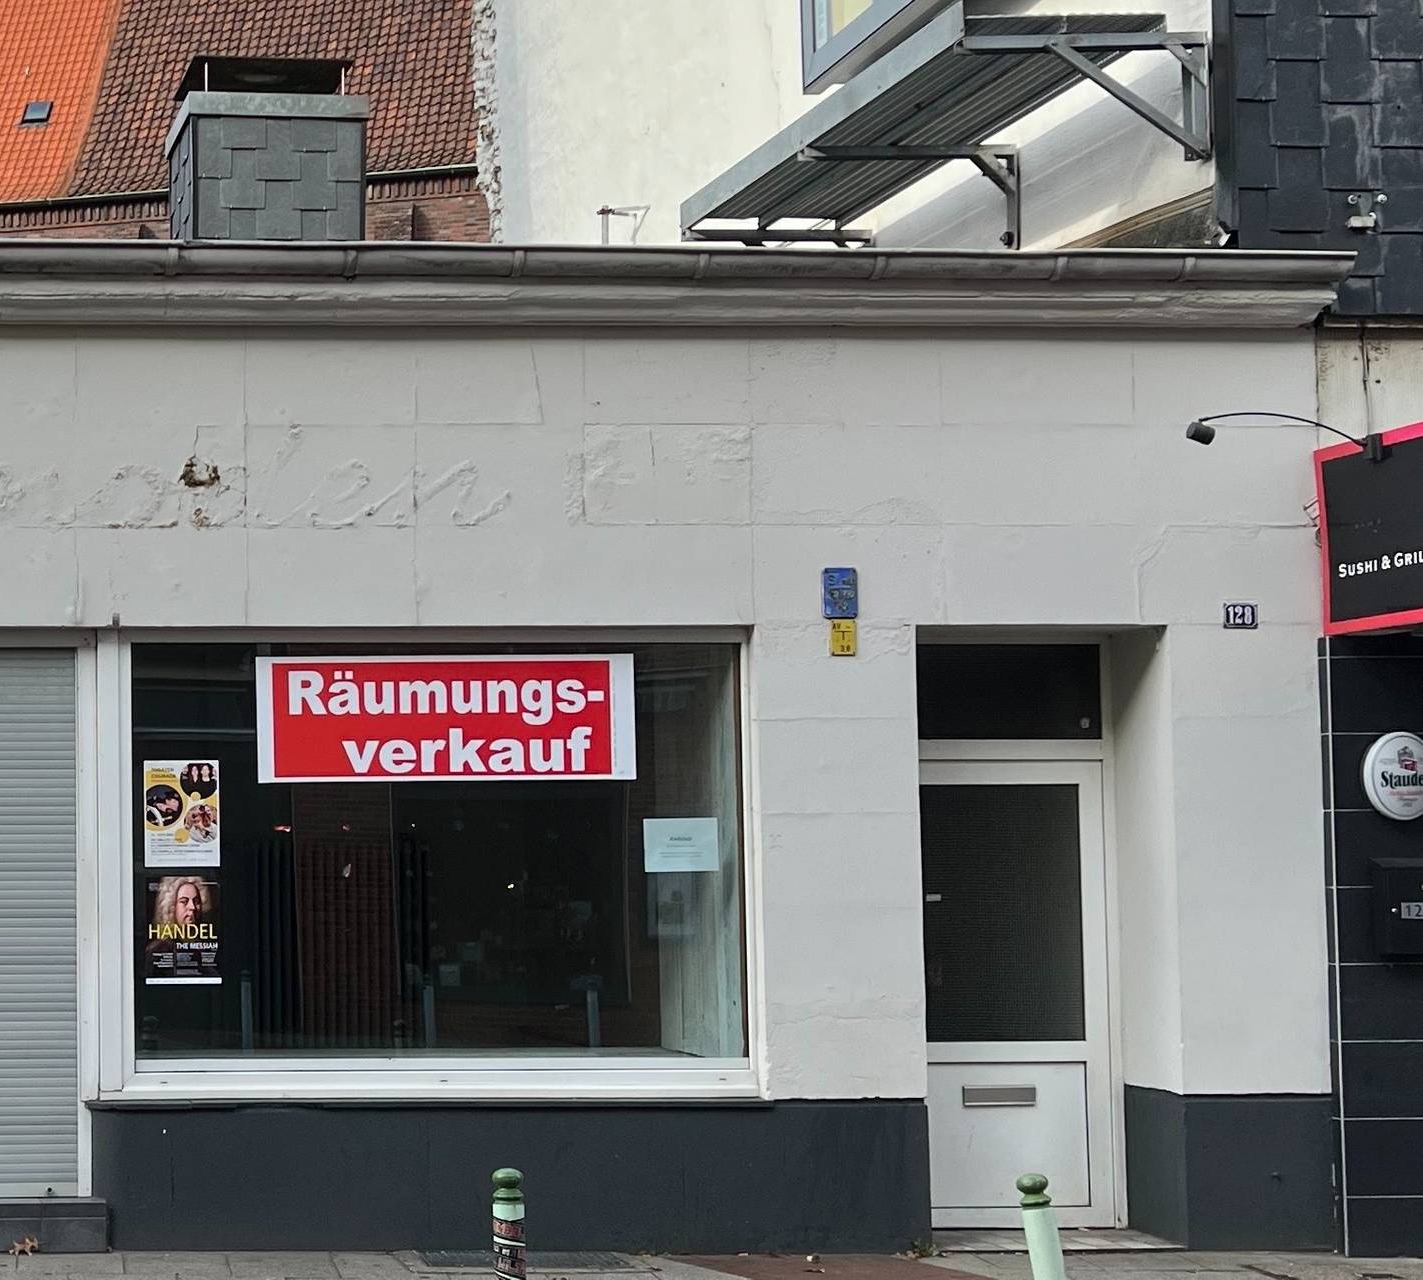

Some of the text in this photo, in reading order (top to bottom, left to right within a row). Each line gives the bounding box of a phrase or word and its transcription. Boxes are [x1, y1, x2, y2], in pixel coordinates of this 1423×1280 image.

[1381, 555, 1391, 570] &
[1227, 606, 1253, 625] 128
[287, 670, 605, 726] Räumungs-
[341, 726, 593, 774] verkauf
